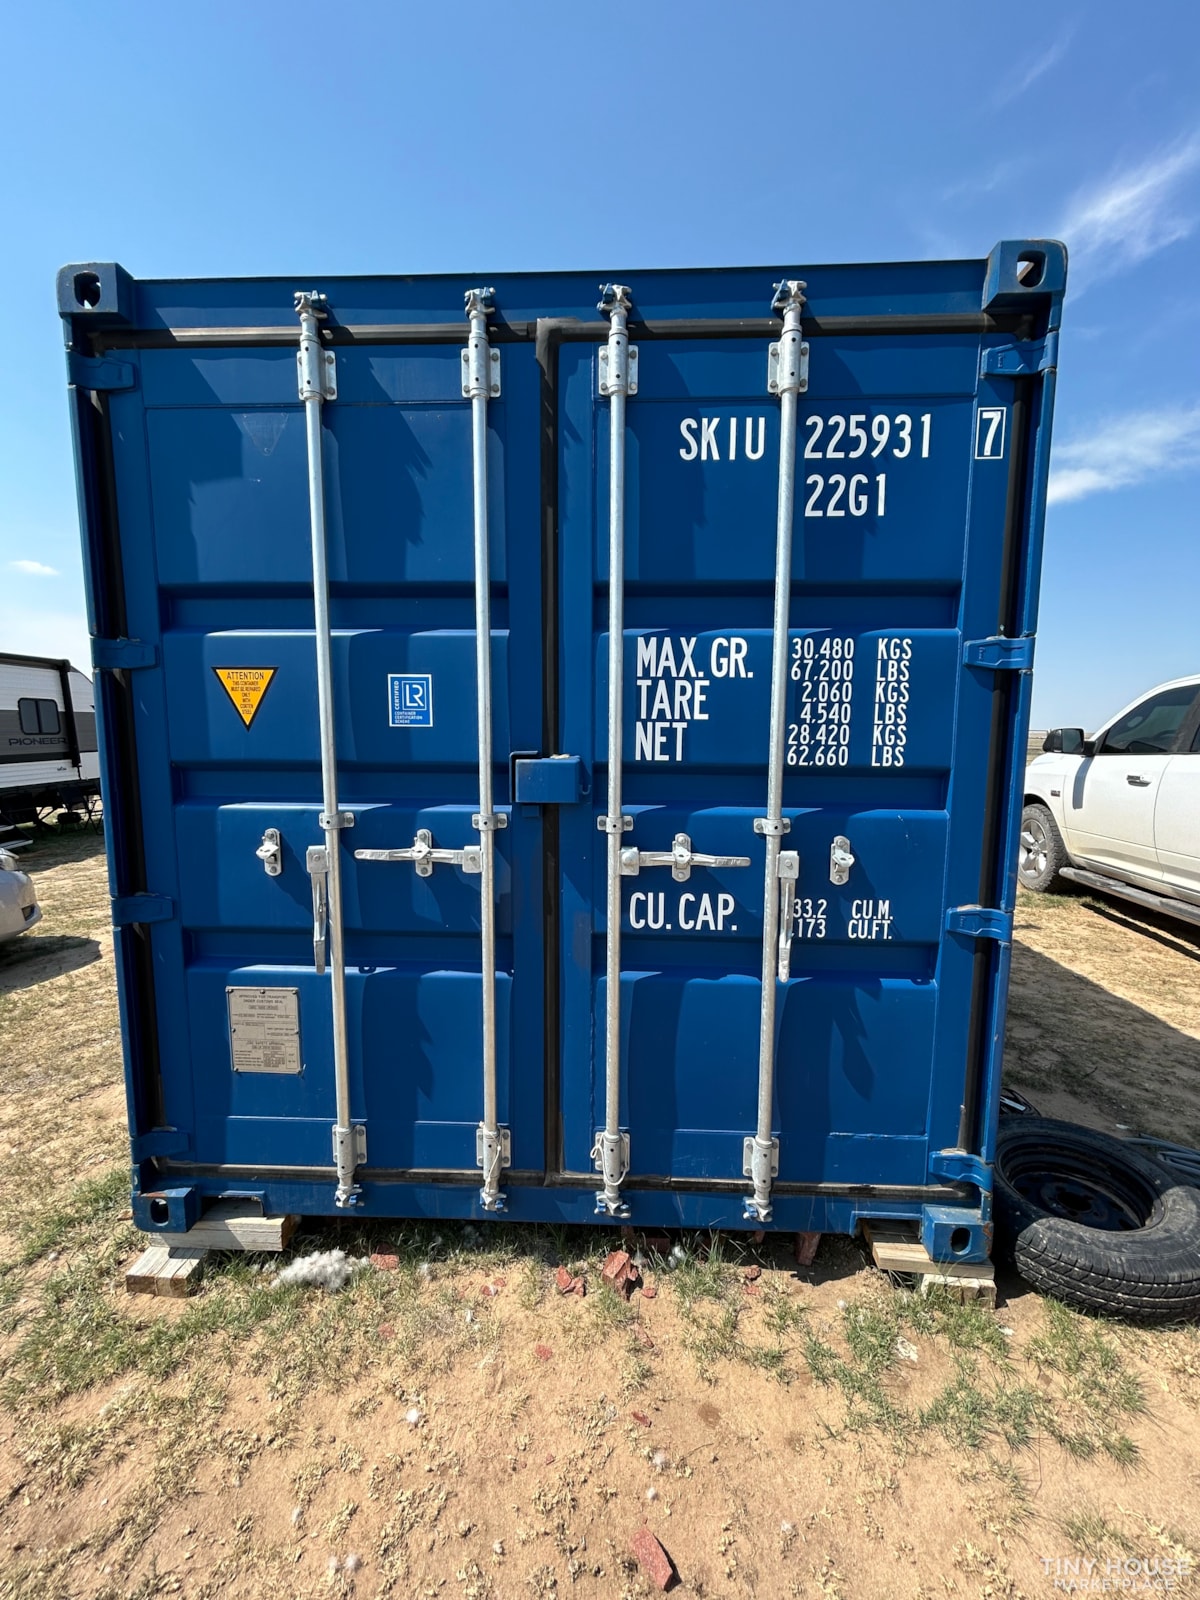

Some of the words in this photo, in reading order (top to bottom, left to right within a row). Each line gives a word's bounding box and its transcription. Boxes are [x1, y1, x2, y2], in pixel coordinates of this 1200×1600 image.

[680, 416, 766, 461] SKIU
[804, 413, 932, 459] 225931
[982, 411, 1002, 456] 7
[804, 473, 886, 517] 22G1
[636, 637, 704, 678] MAX.
[710, 637, 754, 678] GR.
[792, 638, 855, 660] 30,480
[878, 638, 913, 660] KGS
[226, 671, 265, 680] ATTENTION
[790, 660, 854, 681] 67,200
[876, 660, 910, 681] LBS
[405, 684, 425, 707] LR
[636, 679, 710, 721] TARE
[801, 681, 853, 703] 2,060
[875, 682, 910, 703] KGS
[800, 703, 851, 724] 4,540
[873, 703, 907, 725] LBS
[9, 737, 68, 746] PIONEER
[635, 721, 688, 762] NET
[788, 724, 850, 745] 28,420
[872, 725, 907, 746] KGS
[787, 745, 849, 766] 62,660
[871, 746, 905, 767] LBS
[629, 891, 672, 930] CU.
[678, 892, 738, 931] CAP.
[793, 899, 828, 919] 33.2
[851, 899, 894, 920] CU.M.
[847, 919, 893, 940] CU.FT.
